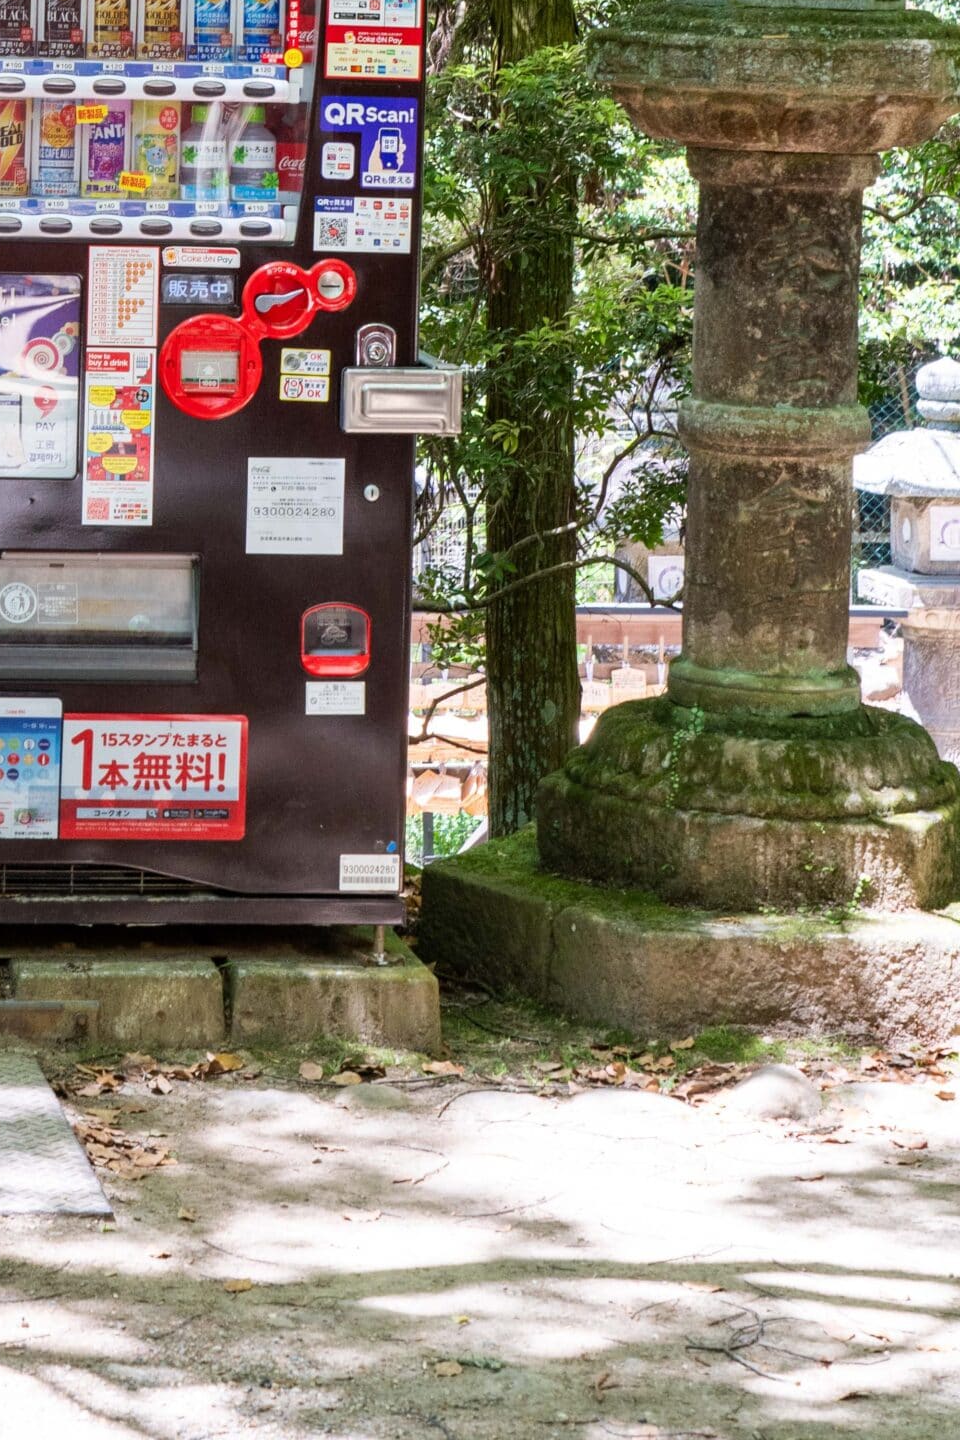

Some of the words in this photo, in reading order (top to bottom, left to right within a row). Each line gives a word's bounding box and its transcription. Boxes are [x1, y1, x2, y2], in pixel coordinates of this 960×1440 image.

[47, 11, 79, 22] BLACK
[96, 10, 129, 19] GOLDEN
[145, 10, 178, 19] GOLDEN
[389, 36, 403, 45] Pay
[77, 107, 104, 120] 新製品
[147, 164, 166, 174] Qoo
[121, 176, 147, 189] 新製品
[364, 174, 412, 185] QRも使える
[181, 255, 202, 263] Coke
[217, 255, 233, 264] Pay
[168, 280, 228, 298] 販売中
[88, 359, 102, 368] buy
[109, 359, 128, 367] drink
[307, 390, 321, 398] OK
[35, 422, 56, 431] PAY
[253, 506, 336, 518] 9300024280
[101, 733, 227, 747] 15スタンプたまると
[71, 728, 226, 792] 1本無料!
